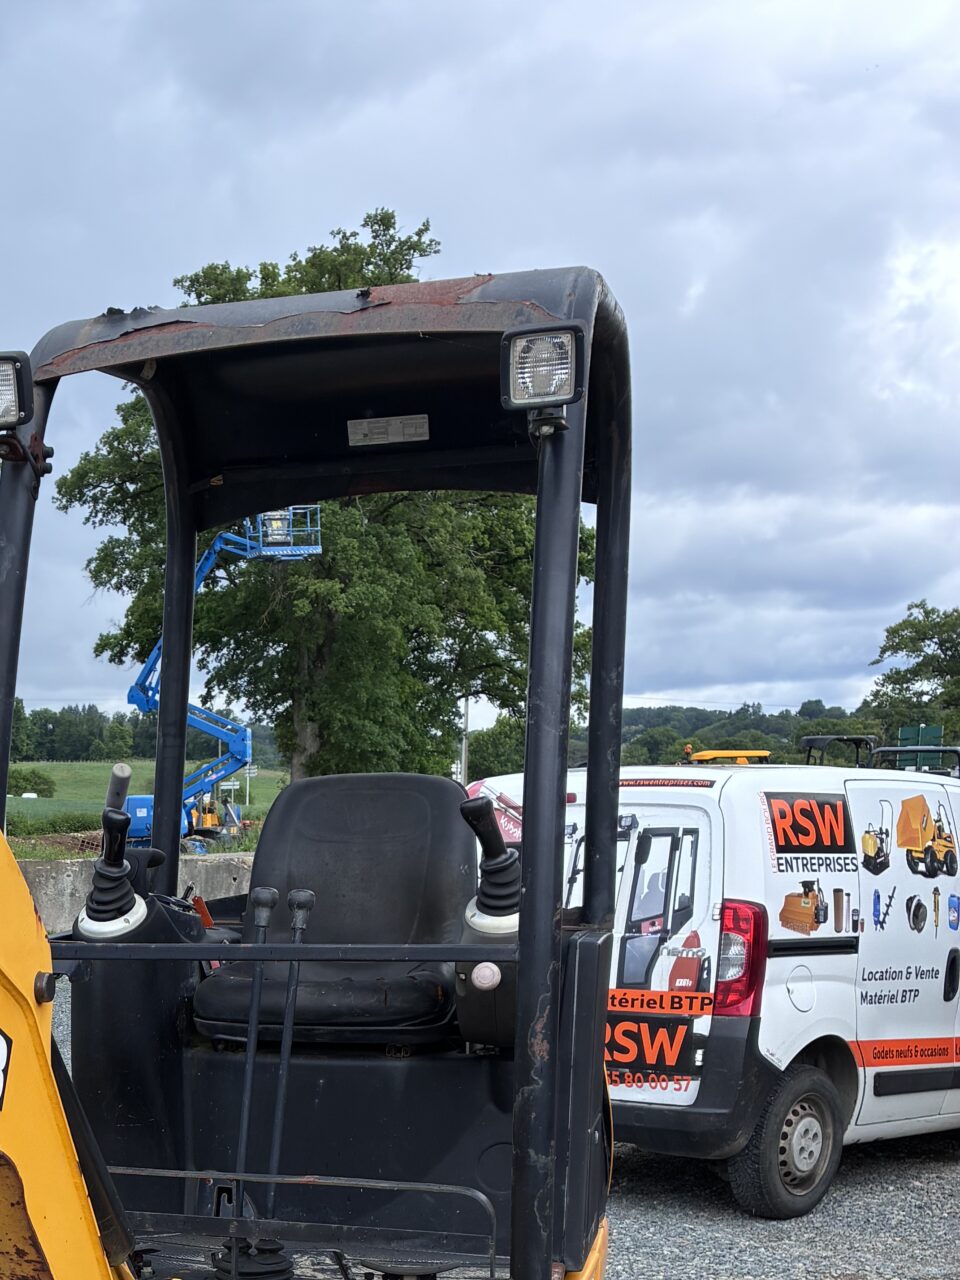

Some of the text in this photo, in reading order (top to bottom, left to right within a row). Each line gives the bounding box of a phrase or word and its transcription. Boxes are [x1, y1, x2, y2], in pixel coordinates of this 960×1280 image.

[771, 799, 845, 847] RSW
[776, 856, 858, 873] ENTREPRISES
[862, 965, 940, 982] Location & Vente
[610, 993, 713, 1011] tériel BTP
[860, 989, 920, 1006] Matériel BTP
[872, 1044, 949, 1060] Godets neufs & occasions
[624, 1072, 644, 1089] 80
[648, 1073, 669, 1091] 00
[673, 1076, 692, 1092] 57
